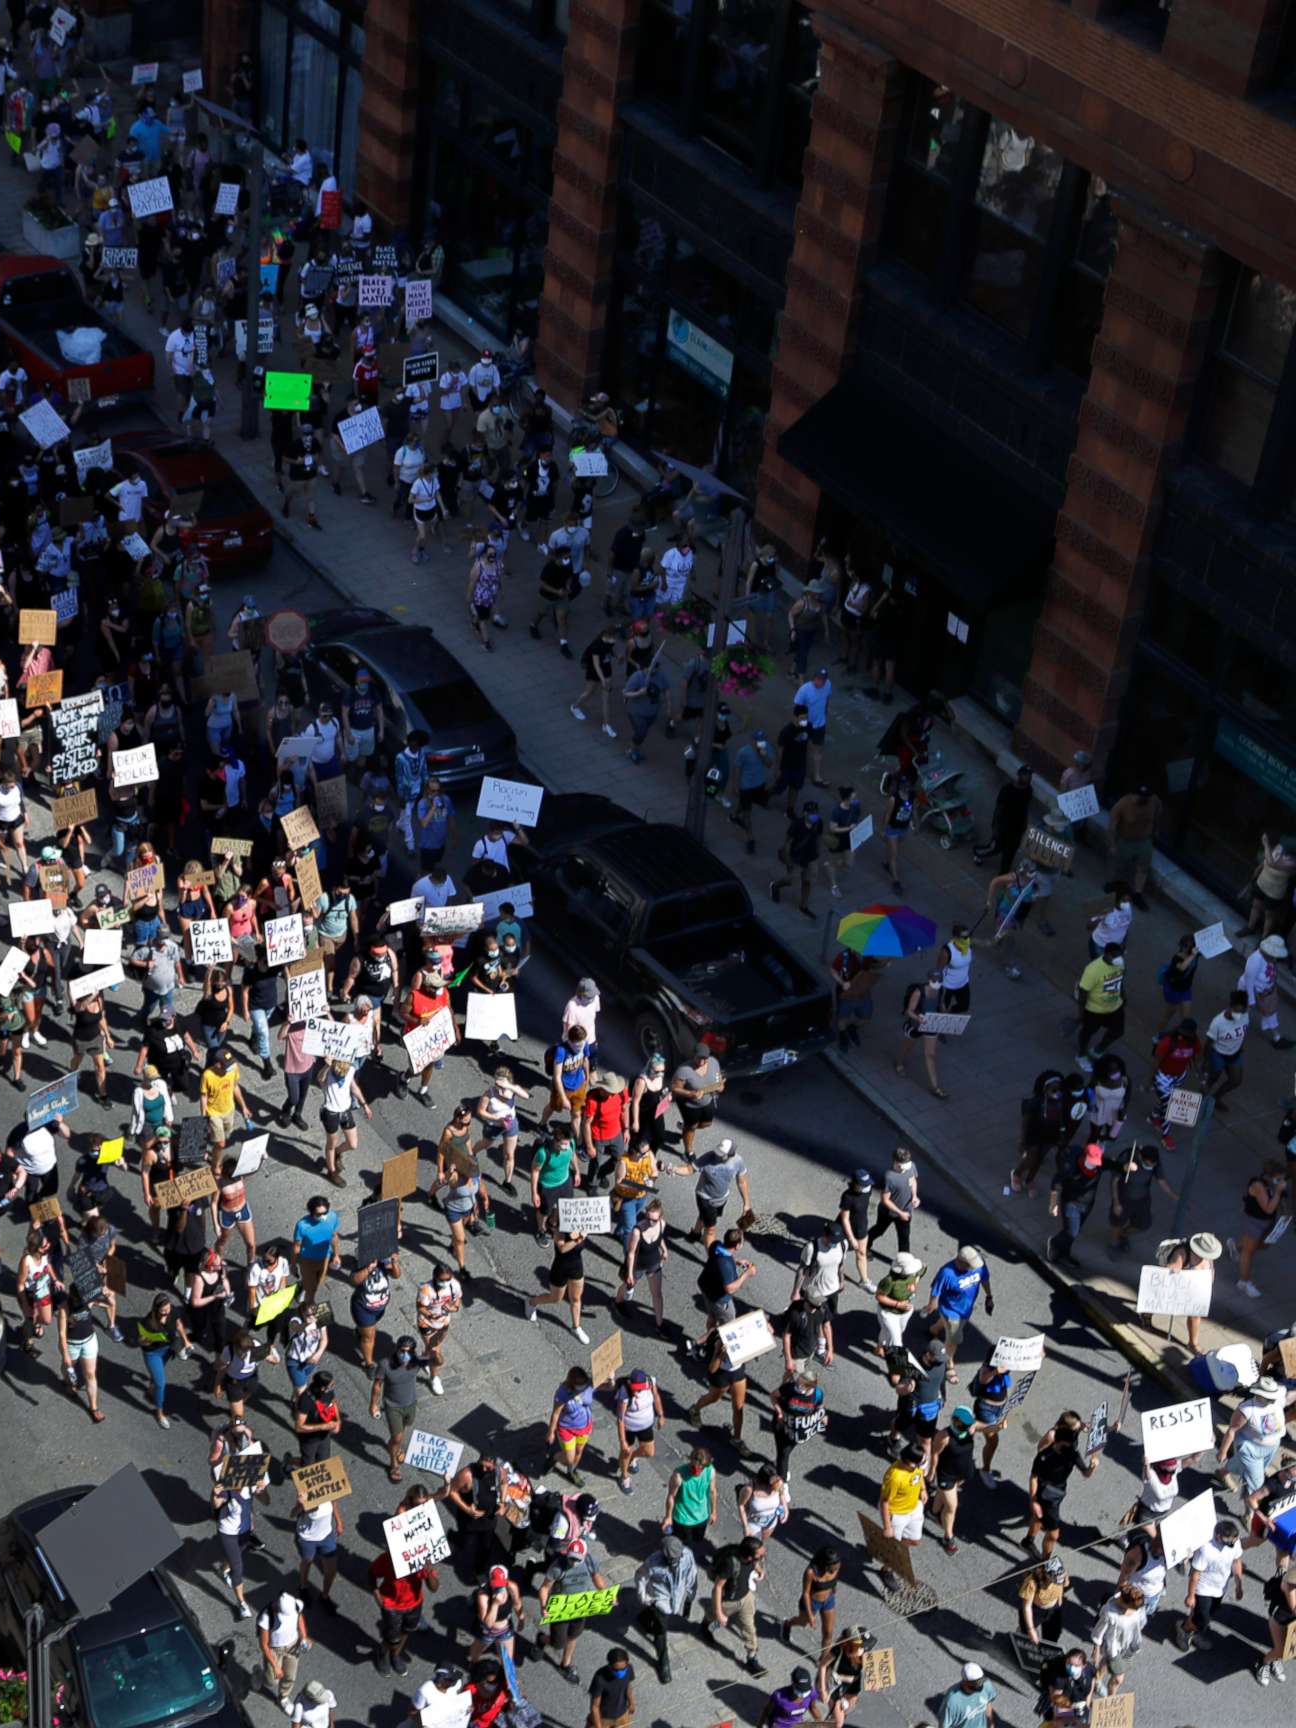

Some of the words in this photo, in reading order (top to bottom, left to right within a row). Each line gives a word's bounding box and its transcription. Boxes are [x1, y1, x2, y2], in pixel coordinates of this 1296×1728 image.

[375, 245, 395, 253] BLACK
[372, 259, 398, 267] MATTER
[362, 295, 392, 304] MATTER
[51, 709, 78, 727] FUCK
[56, 716, 98, 738] SYSTEM
[62, 733, 91, 751] YOUR
[52, 744, 96, 769] SYSTEM
[117, 749, 153, 766] DEFUN
[52, 758, 98, 784] FUCKED
[118, 767, 154, 784] POLICE
[1028, 827, 1070, 858] SILENCE
[191, 921, 224, 936] Black
[267, 920, 296, 936] Black
[194, 937, 226, 947] Lives
[268, 933, 297, 949] Lives
[195, 947, 230, 961] Matter
[289, 972, 320, 988] Black
[290, 987, 322, 1003] Lives
[411, 1028, 451, 1060] CHANGE
[415, 1041, 450, 1071] REFORM
[561, 1208, 573, 1216] NO
[573, 1207, 605, 1216] JUSTICE
[580, 1215, 607, 1224] RACIST
[570, 1223, 601, 1231] SYSTEM
[1150, 1402, 1207, 1431] RESIST
[785, 1422, 826, 1444] LICE
[417, 1433, 448, 1451] BLACK
[298, 1463, 328, 1480] BLACK
[410, 1454, 450, 1473] MATTER
[306, 1480, 347, 1501] MATTER!
[550, 1589, 615, 1606] BLACK
[1098, 1696, 1126, 1710] BLACK
[1097, 1708, 1126, 1721] LIVES
